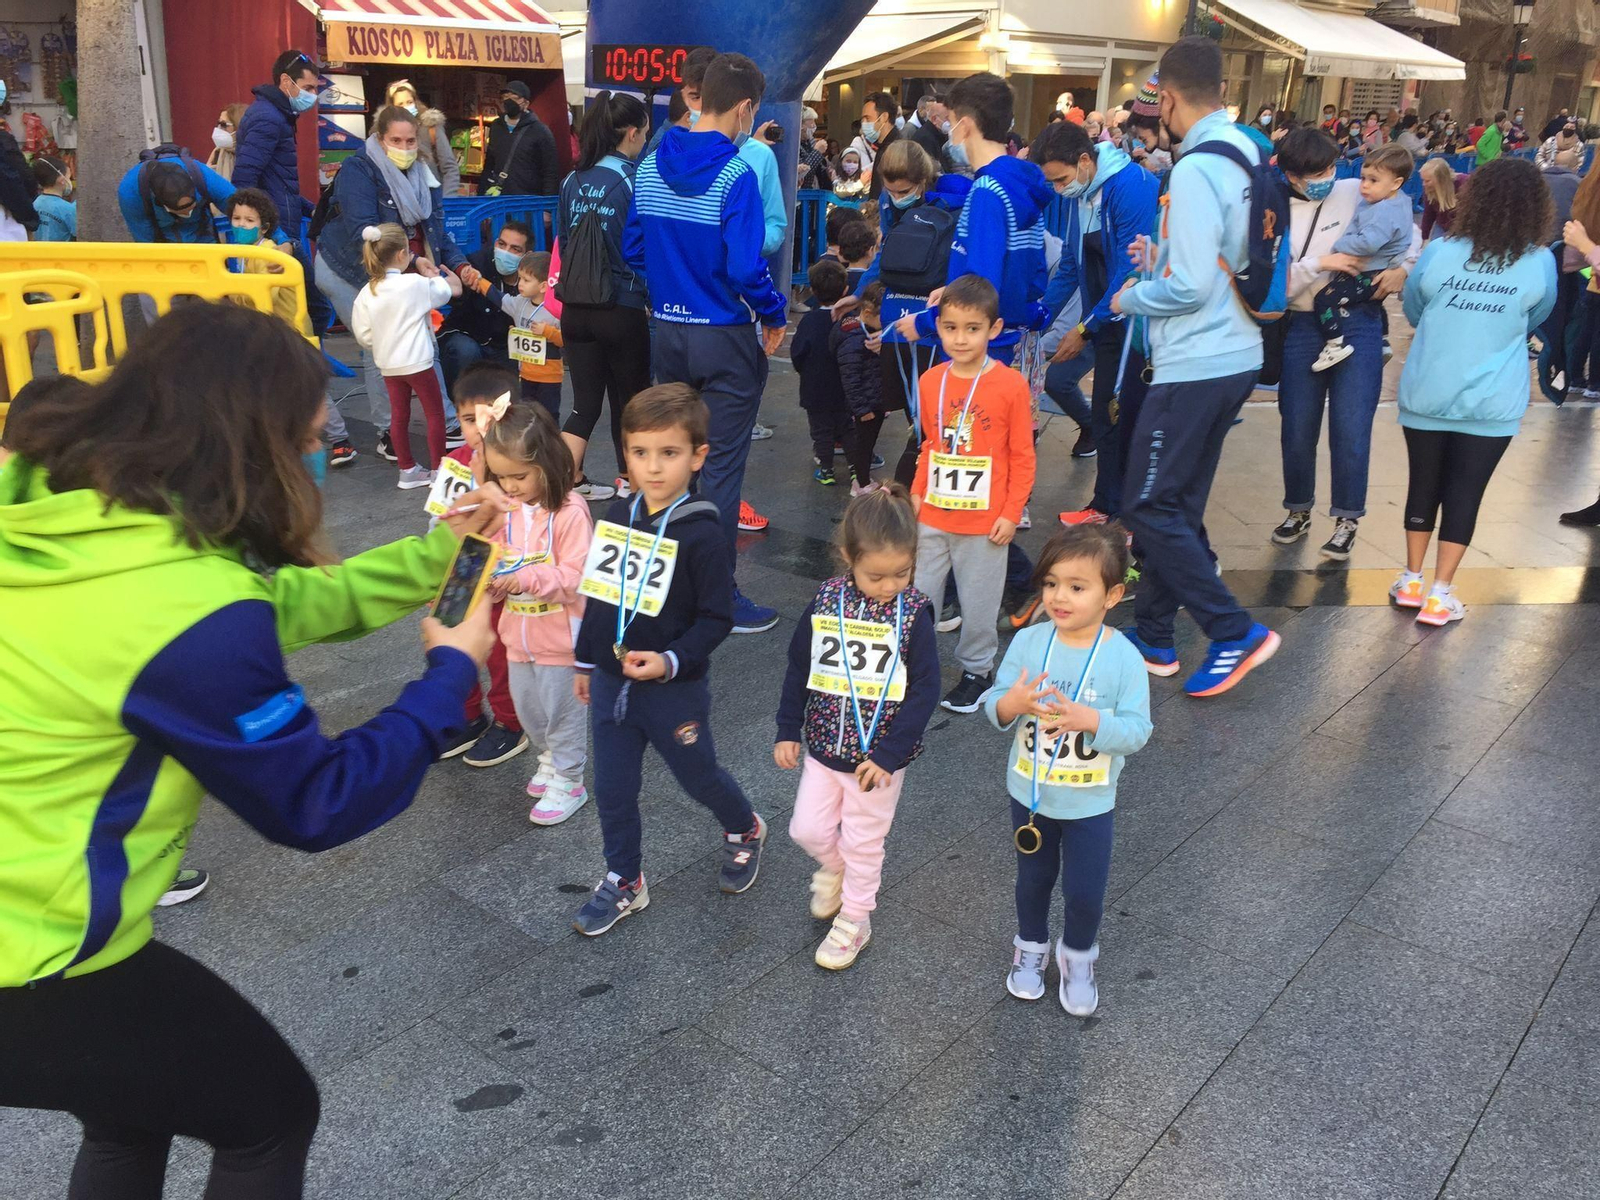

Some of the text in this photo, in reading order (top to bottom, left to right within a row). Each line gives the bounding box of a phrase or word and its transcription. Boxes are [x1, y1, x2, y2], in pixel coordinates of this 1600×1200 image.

[346, 26, 545, 63] KIOSCO PLAZA IGLESIA
[578, 183, 607, 198] Club
[1463, 259, 1505, 275] Club
[1438, 275, 1518, 295] Atletismo
[663, 303, 692, 315] C.A.L.
[1445, 294, 1506, 313] Linense
[513, 336, 542, 353] 165
[933, 467, 984, 492] 117
[595, 544, 666, 588] 262
[818, 636, 893, 673] 237
